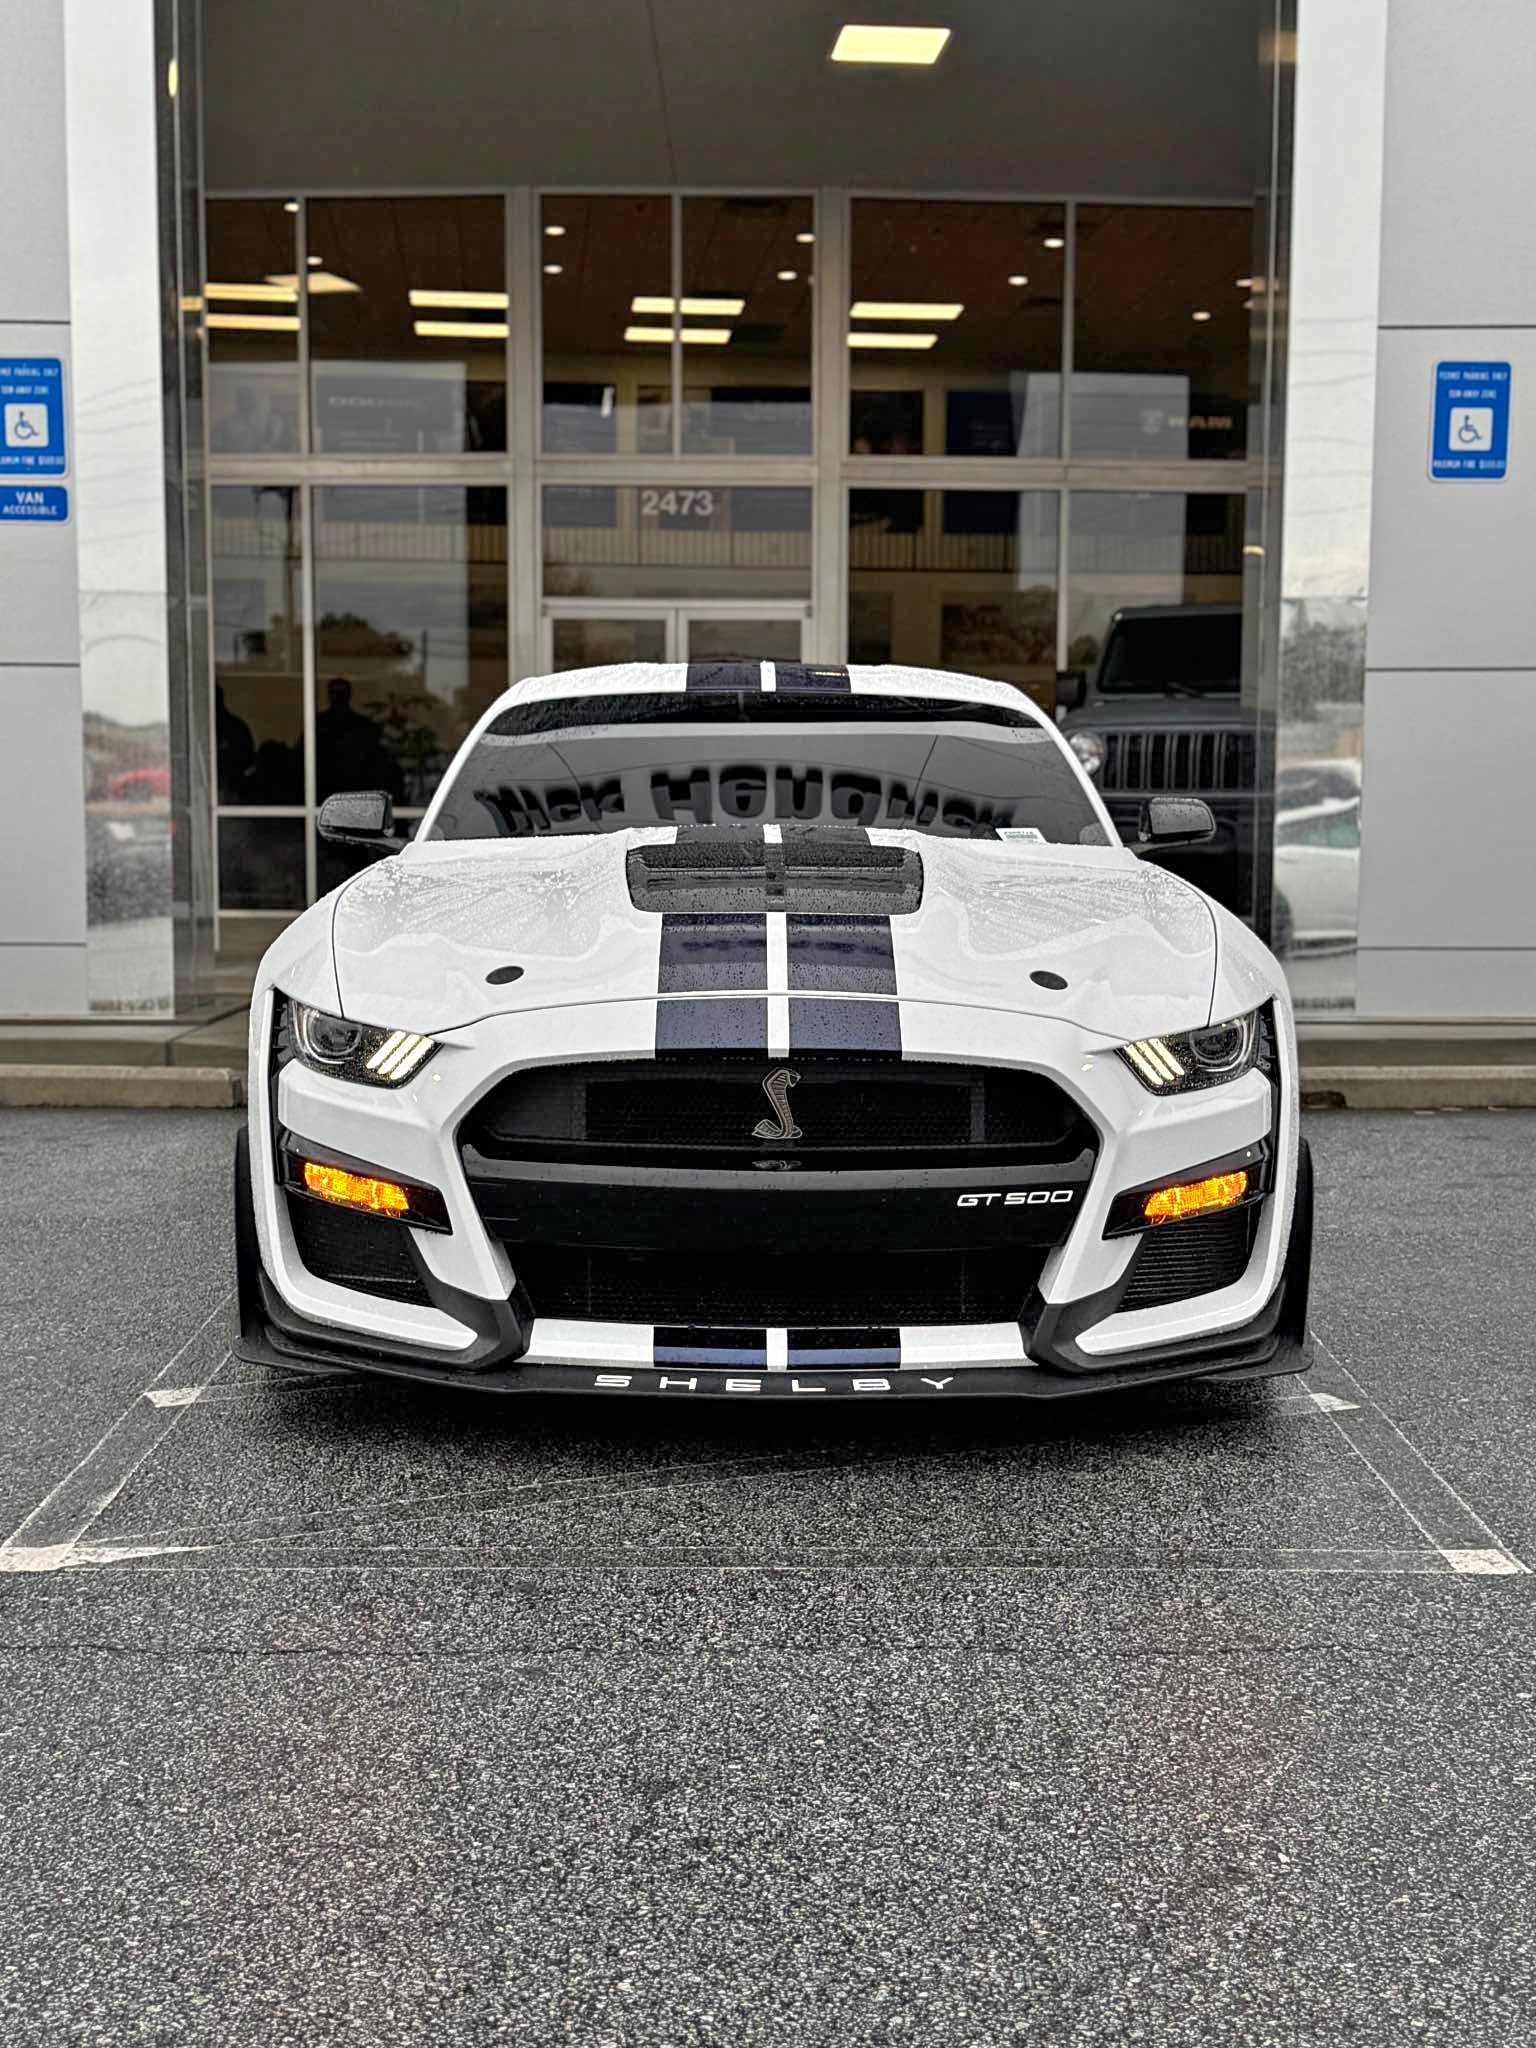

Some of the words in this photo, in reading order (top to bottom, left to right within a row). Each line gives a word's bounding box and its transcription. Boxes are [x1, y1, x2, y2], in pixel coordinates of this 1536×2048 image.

[16, 492, 44, 505] VAN
[641, 489, 715, 516] 2473
[2, 505, 57, 516] ACCESSIBLE
[593, 1373, 955, 1393] SHELBY
